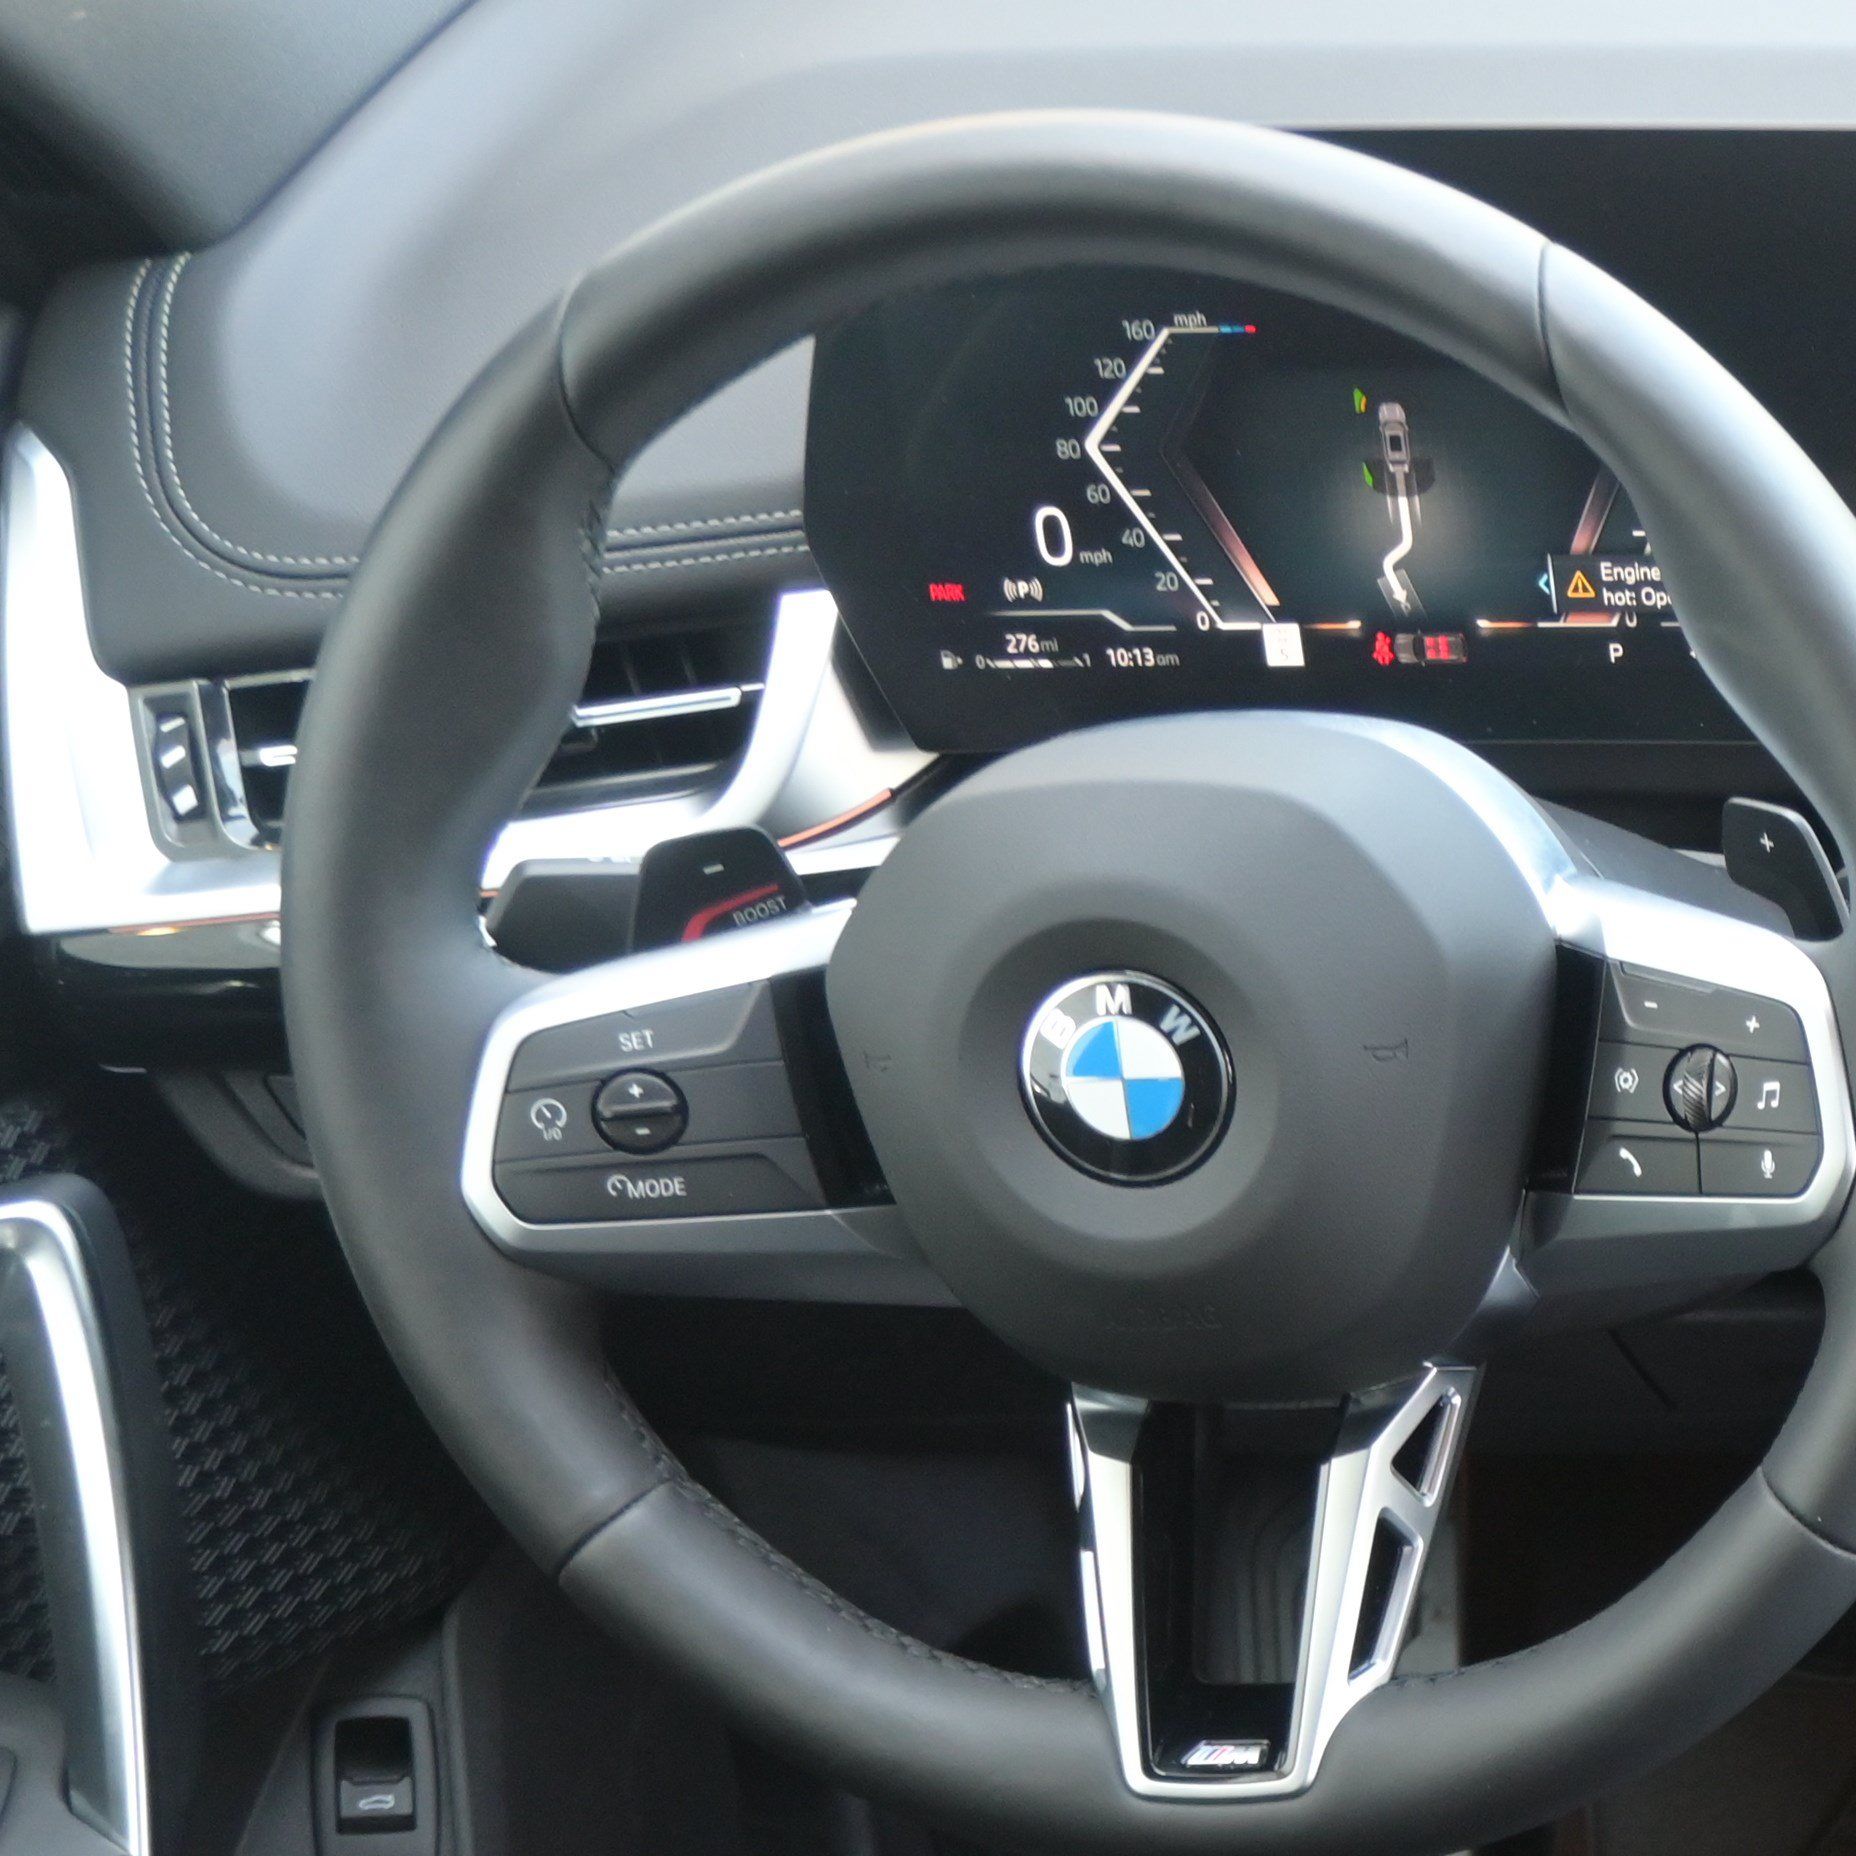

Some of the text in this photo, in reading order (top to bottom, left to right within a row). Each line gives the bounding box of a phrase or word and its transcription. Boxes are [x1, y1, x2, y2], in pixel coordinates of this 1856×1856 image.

[1122, 319, 1155, 341] 160
[1174, 311, 1206, 328] mph
[1094, 358, 1126, 379] 120
[1064, 397, 1099, 418] 100
[1056, 439, 1081, 459] 80
[1086, 485, 1111, 504] 60
[1035, 505, 1112, 567] 0 mph
[1121, 528, 1145, 549] 40
[1155, 572, 1179, 591] 20
[1600, 561, 1661, 585] Engine
[929, 583, 966, 601] PARK
[1602, 587, 1637, 606] hot:
[1196, 612, 1211, 631] 0
[1609, 643, 1624, 663] P
[733, 896, 786, 926] BOOST
[1040, 984, 1200, 1049] BMW
[618, 1029, 654, 1051] SET
[627, 1177, 687, 1199] MODE
